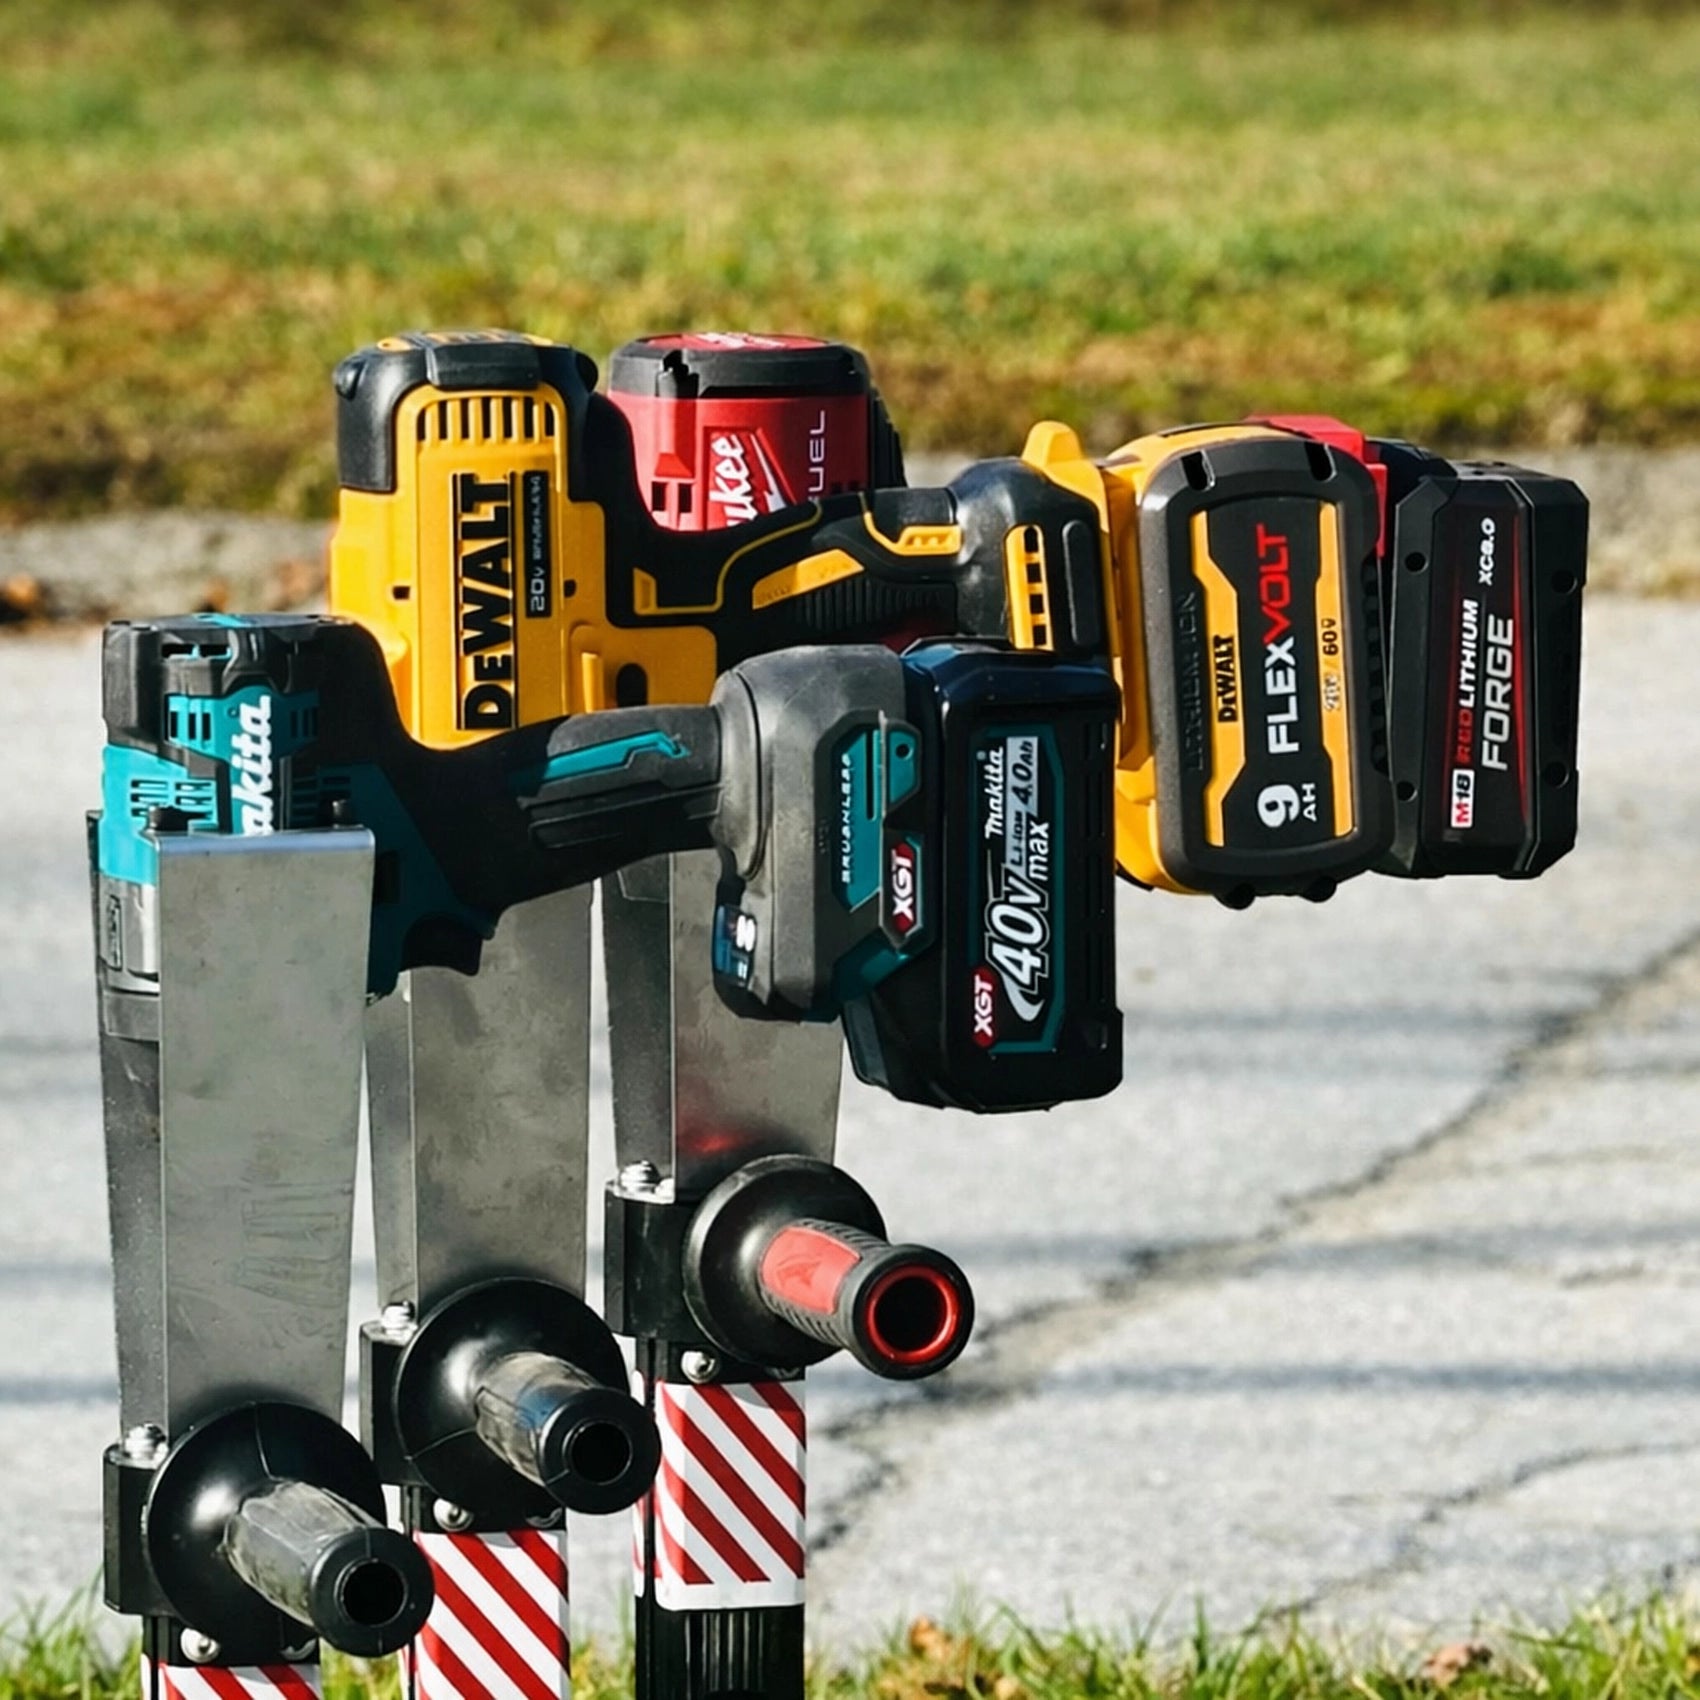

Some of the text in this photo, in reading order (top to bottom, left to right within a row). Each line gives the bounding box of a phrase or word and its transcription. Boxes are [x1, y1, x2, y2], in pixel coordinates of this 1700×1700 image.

[708, 434, 758, 526] ukee
[808, 410, 826, 500] UEL
[461, 473, 513, 730] DEWALT
[1256, 523, 1300, 755] FLEXVOLT
[1213, 635, 1238, 723] DEWALT
[1482, 614, 1514, 771] FORGE
[231, 694, 274, 836] akita
[1257, 783, 1301, 828] 9
[1454, 773, 1473, 825] M18
[892, 848, 914, 922] XGT
[973, 974, 993, 1038] XGT
